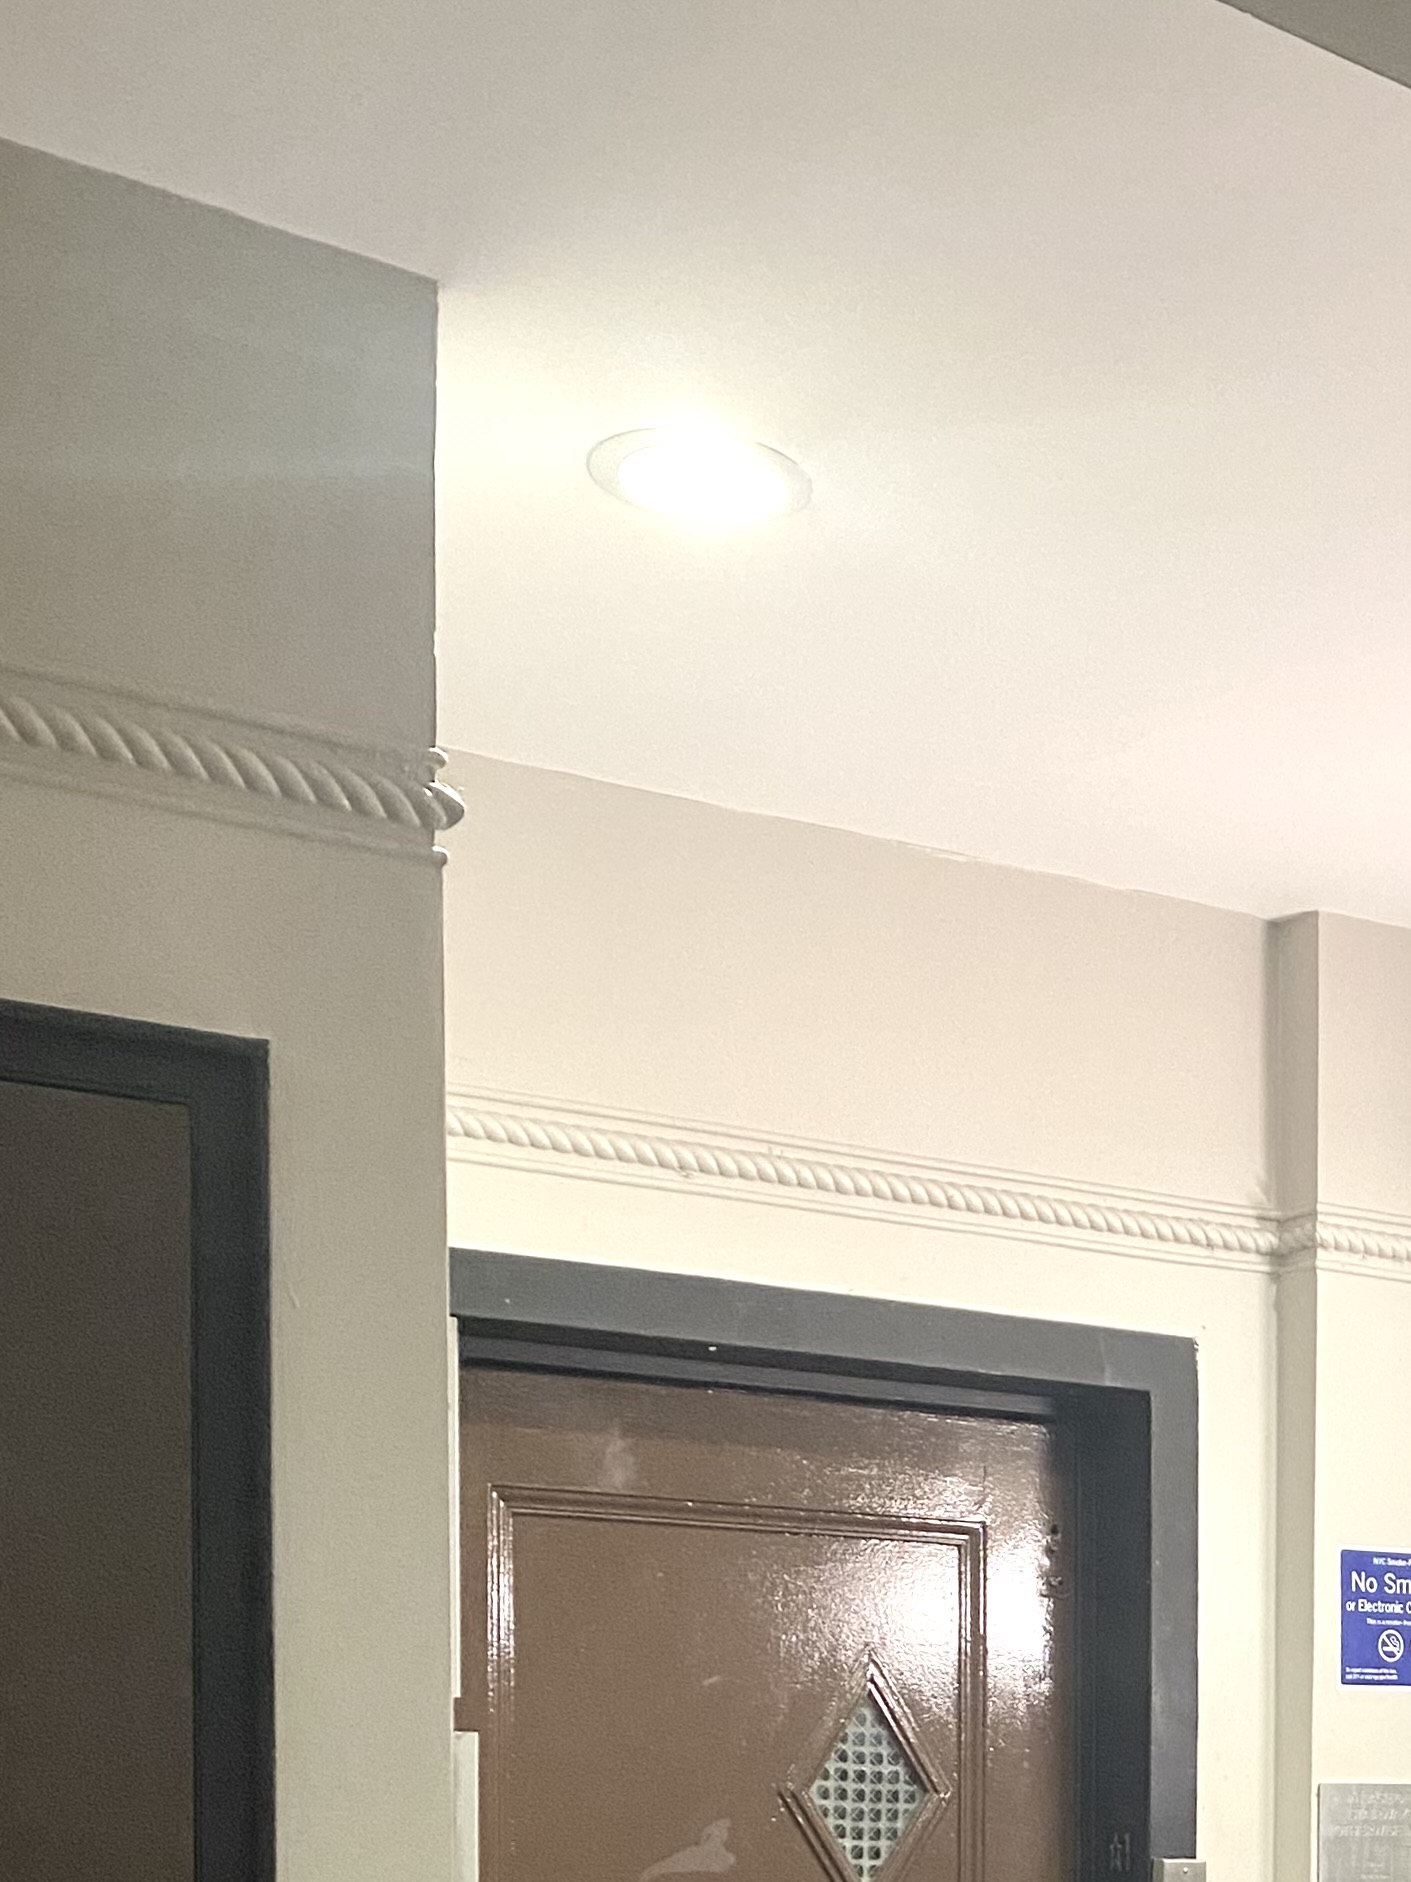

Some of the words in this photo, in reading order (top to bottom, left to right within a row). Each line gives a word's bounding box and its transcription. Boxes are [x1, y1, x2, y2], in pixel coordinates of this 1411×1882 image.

[1373, 1557, 1386, 1565] NYC
[1351, 1570, 1378, 1593] No
[1346, 1601, 1356, 1611] or
[1357, 1598, 1404, 1614] Electronic
